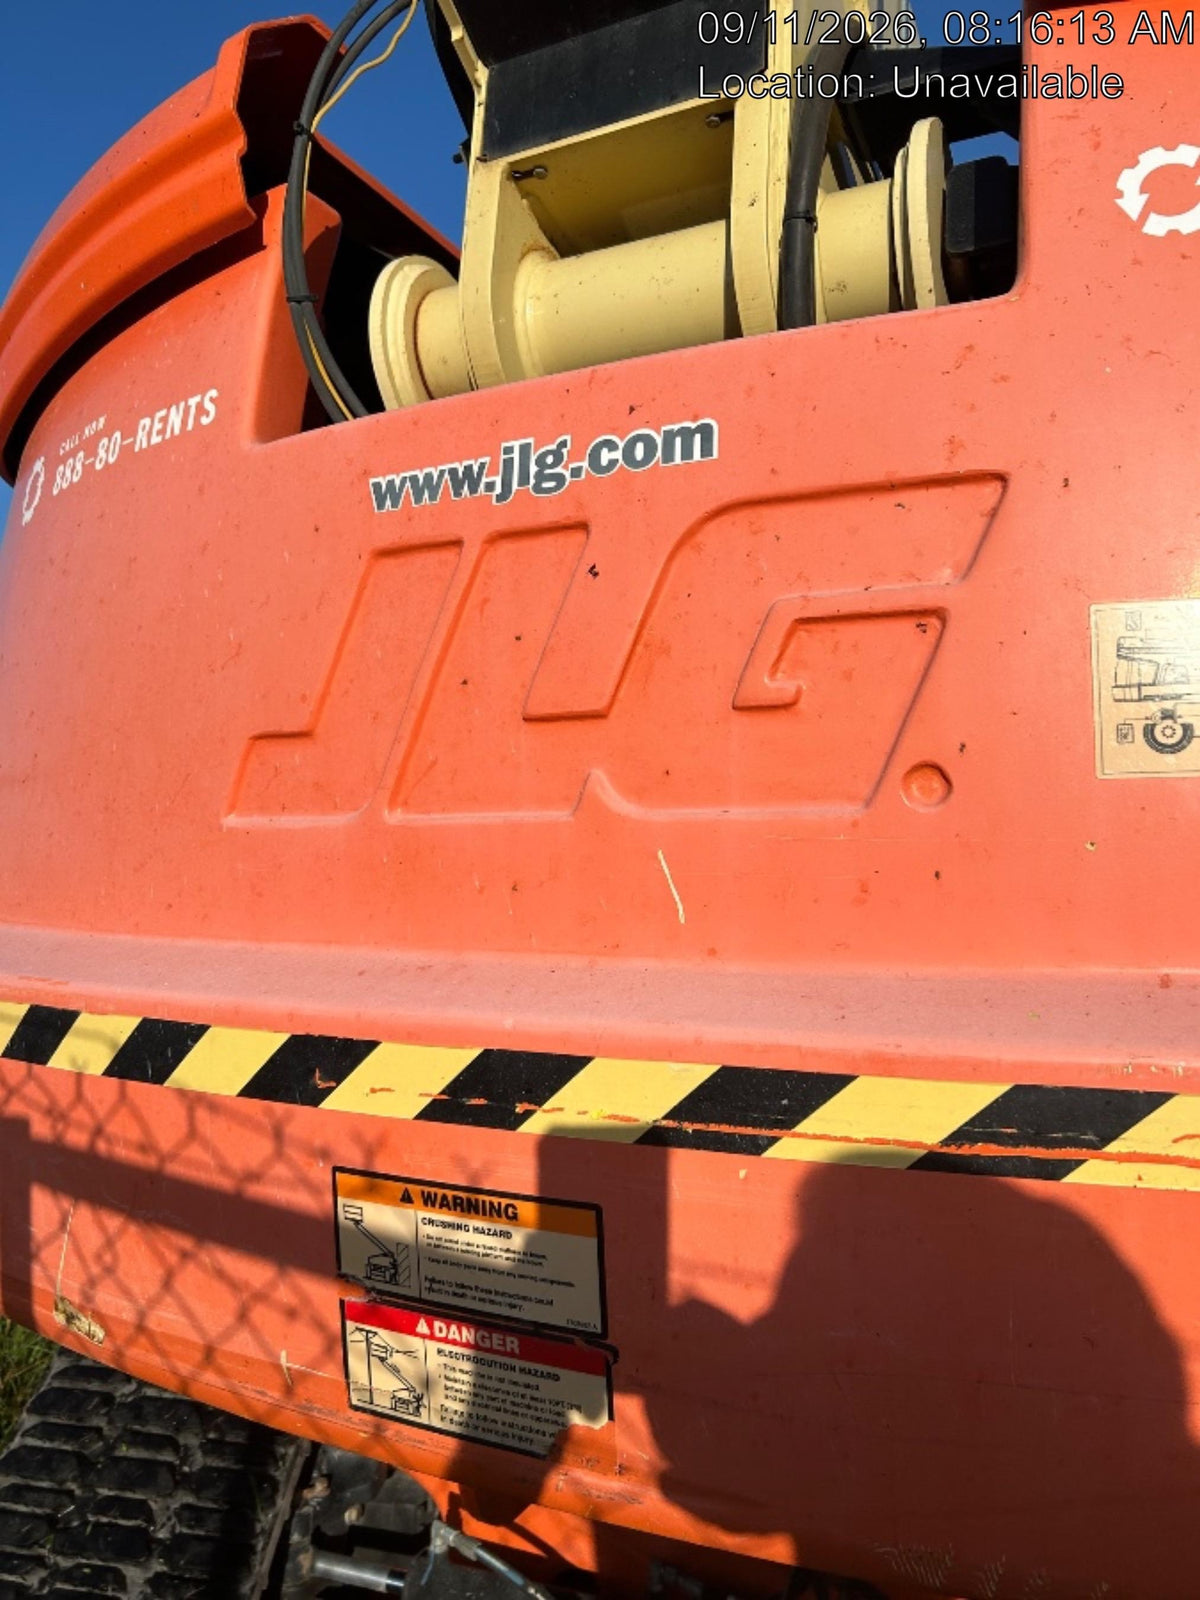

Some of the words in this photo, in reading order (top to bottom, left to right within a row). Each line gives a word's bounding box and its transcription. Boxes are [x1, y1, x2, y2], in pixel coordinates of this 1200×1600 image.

[53, 388, 219, 496] 888-80-RENTS
[369, 419, 719, 512] www.jlg.com
[420, 1189, 519, 1222] WARNING
[421, 1217, 470, 1233] CRUSHING
[473, 1225, 513, 1240] HAZARD
[433, 1319, 520, 1355] DANGER
[518, 1364, 561, 1382] HAZARD
